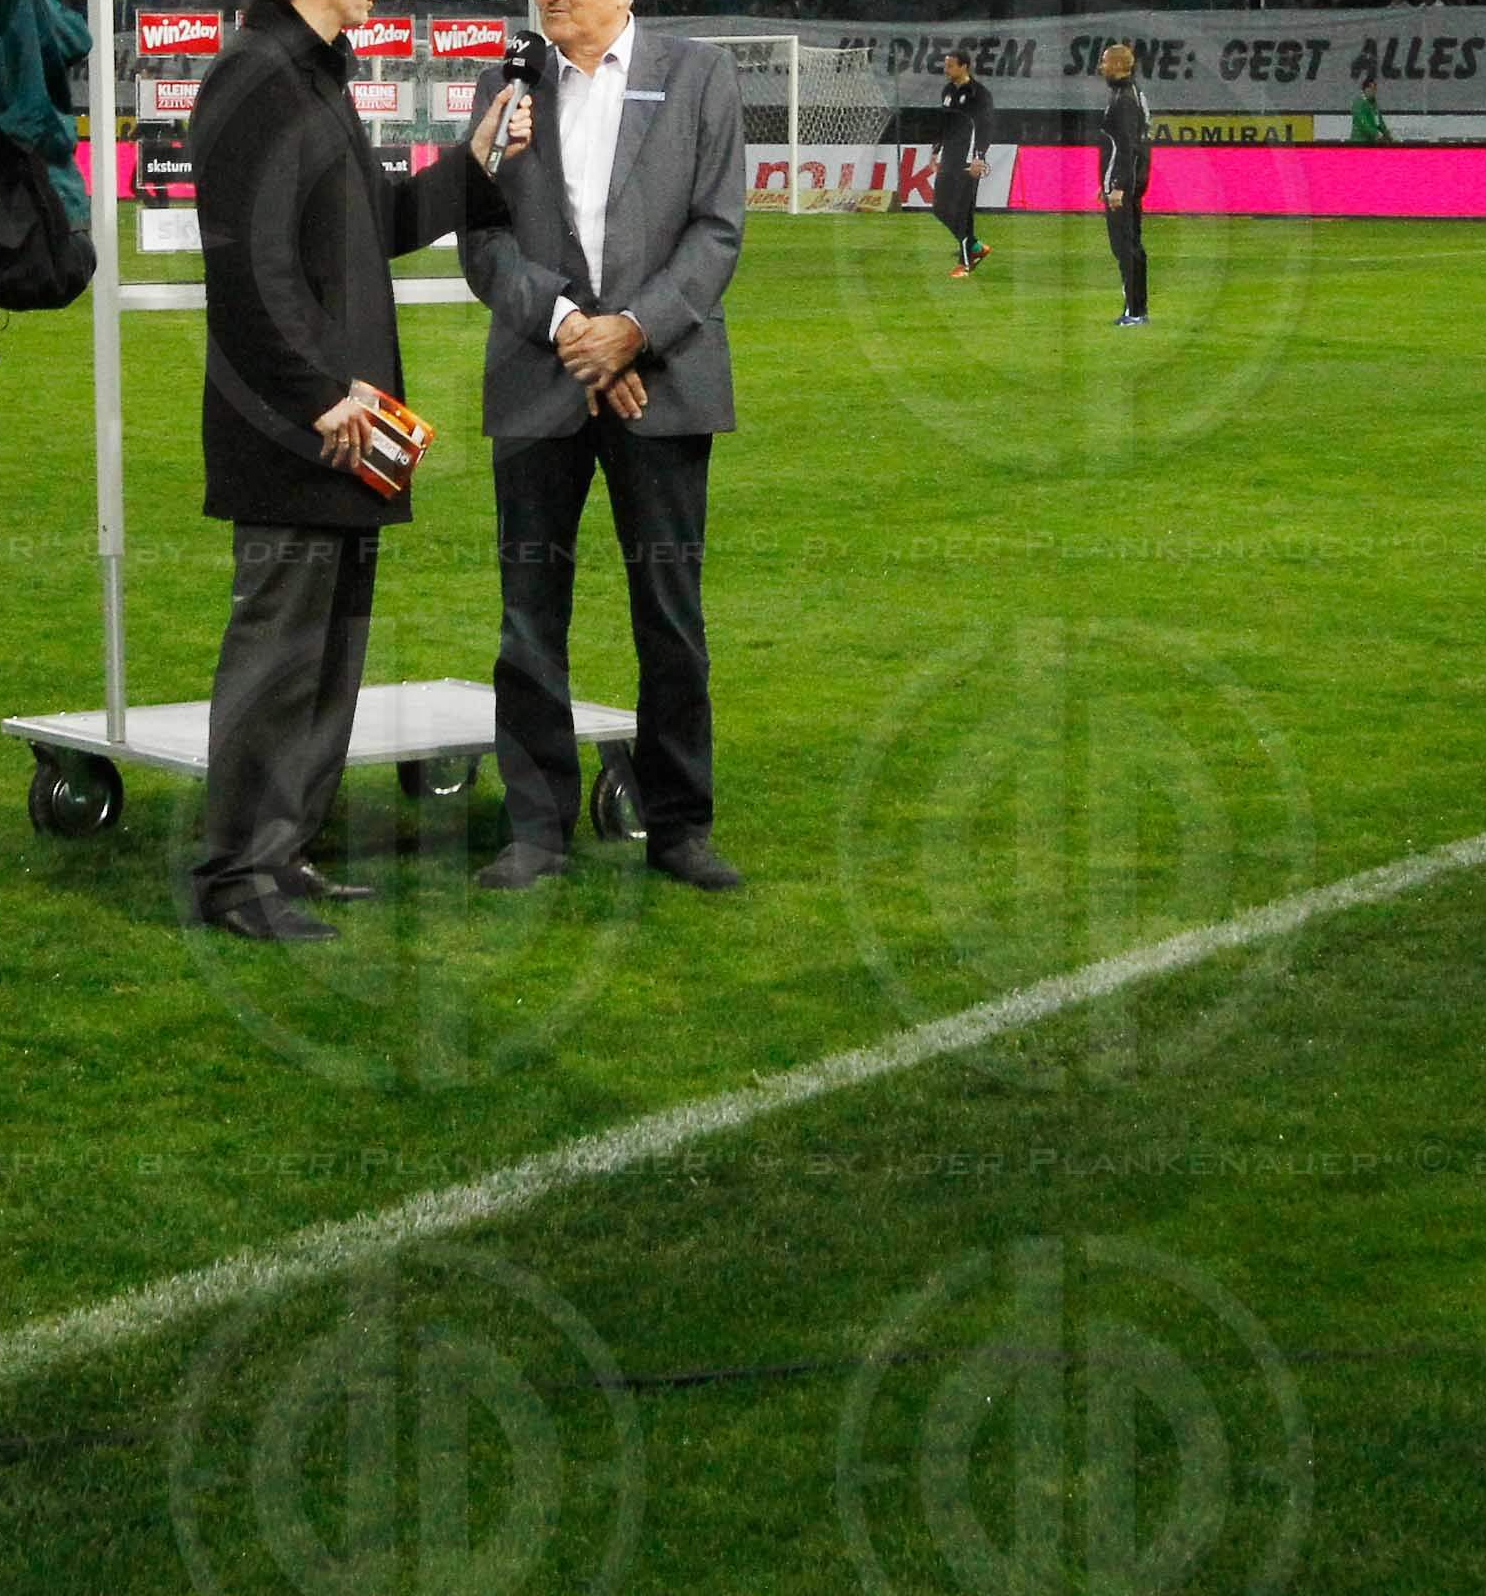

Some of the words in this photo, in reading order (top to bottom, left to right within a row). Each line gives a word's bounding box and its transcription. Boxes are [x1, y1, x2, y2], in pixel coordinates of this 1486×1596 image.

[141, 18, 218, 49] win2day
[433, 22, 504, 52] win2day
[887, 34, 1037, 78] DIESEM
[1219, 38, 1331, 82] GEBT
[1350, 37, 1486, 80] ALLES
[156, 97, 195, 110] ZEITUN
